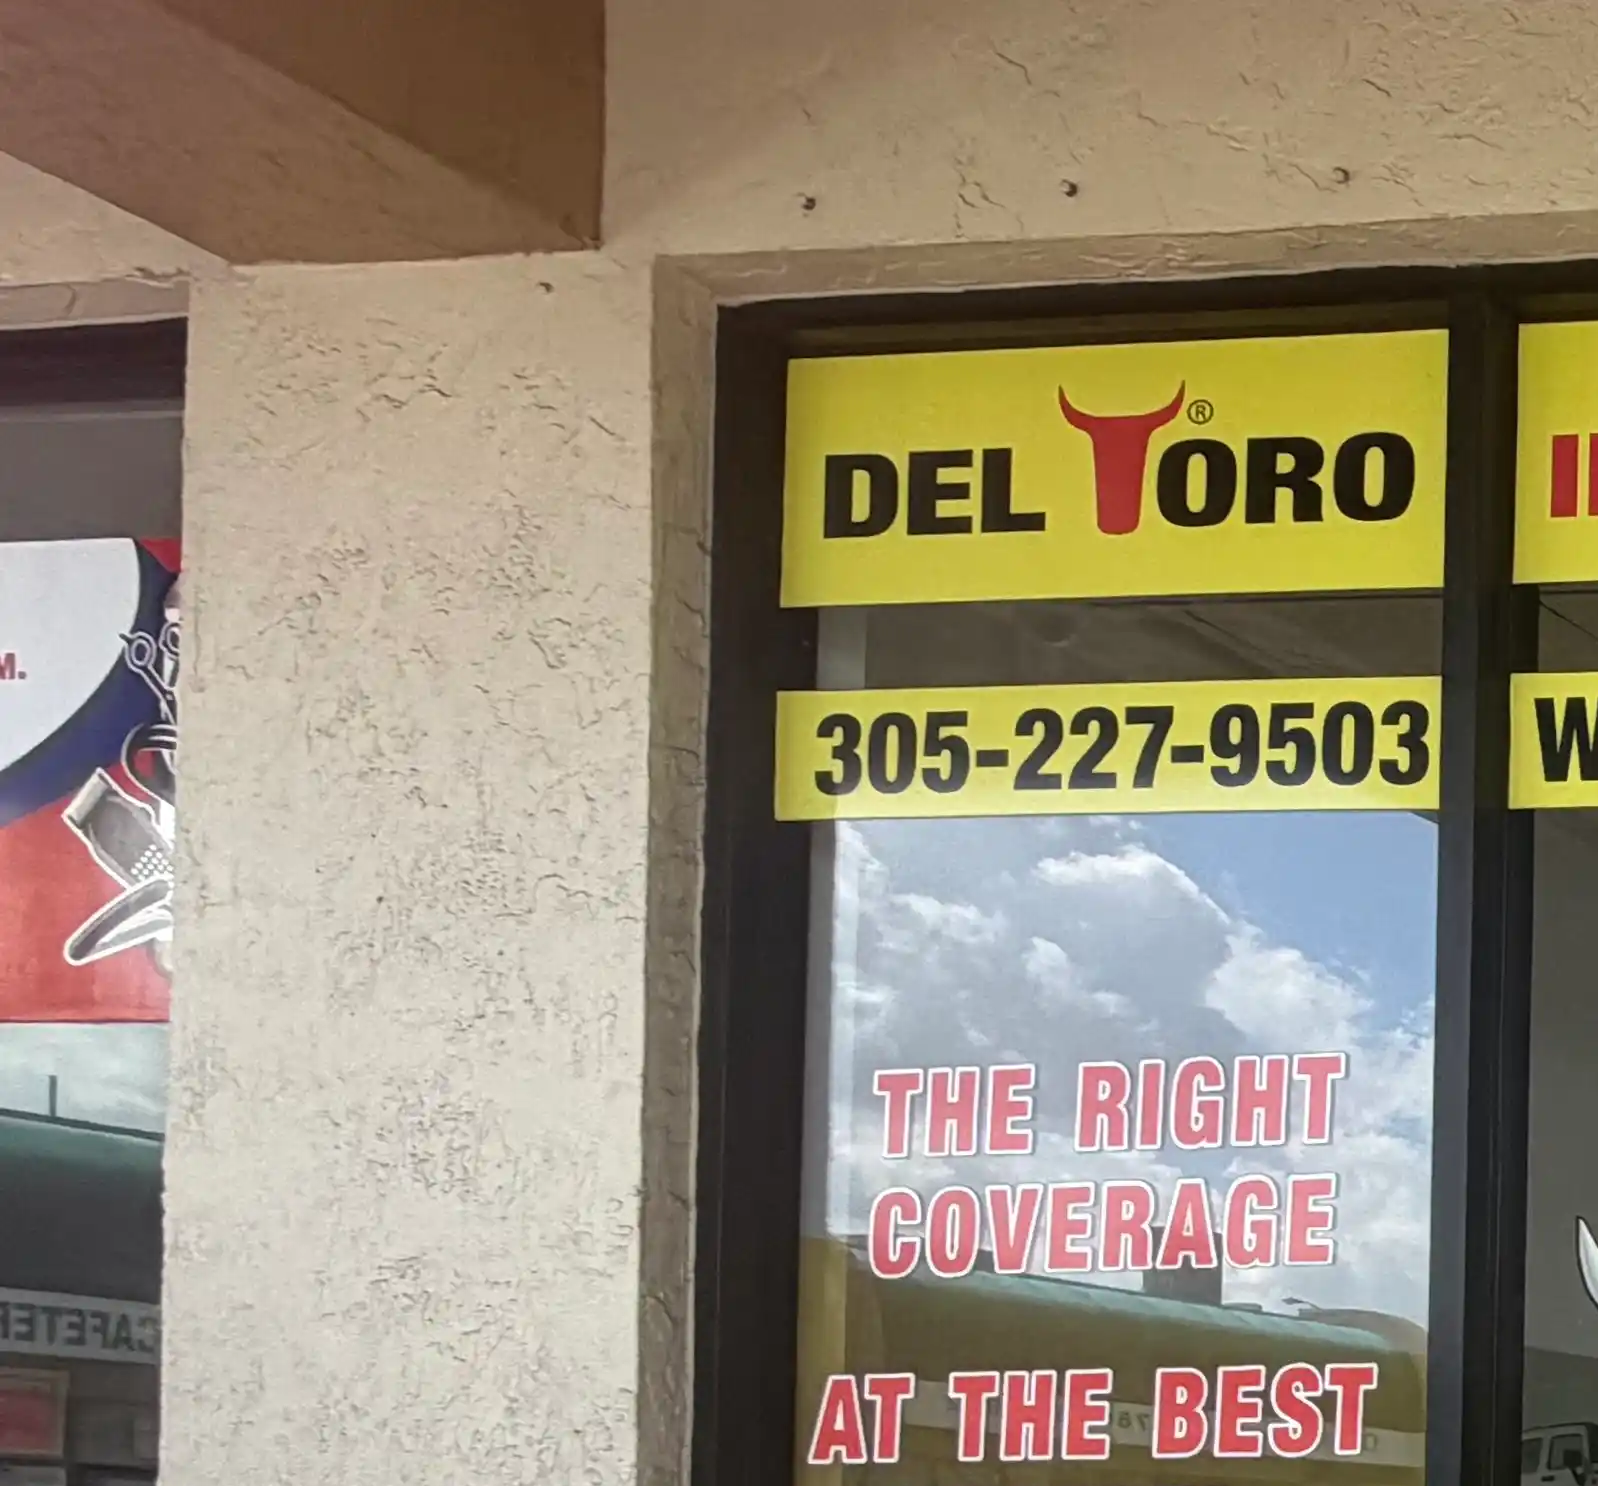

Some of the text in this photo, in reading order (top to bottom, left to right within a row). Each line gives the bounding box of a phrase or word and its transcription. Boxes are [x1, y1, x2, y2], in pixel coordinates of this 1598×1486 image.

[823, 447, 1046, 538] DEL
[815, 701, 1431, 796] 305-227-9503
[873, 1052, 1347, 1159] THE RIGHT
[868, 1172, 1337, 1279] COVERAGE
[808, 1361, 1378, 1464] AT THE BEST
